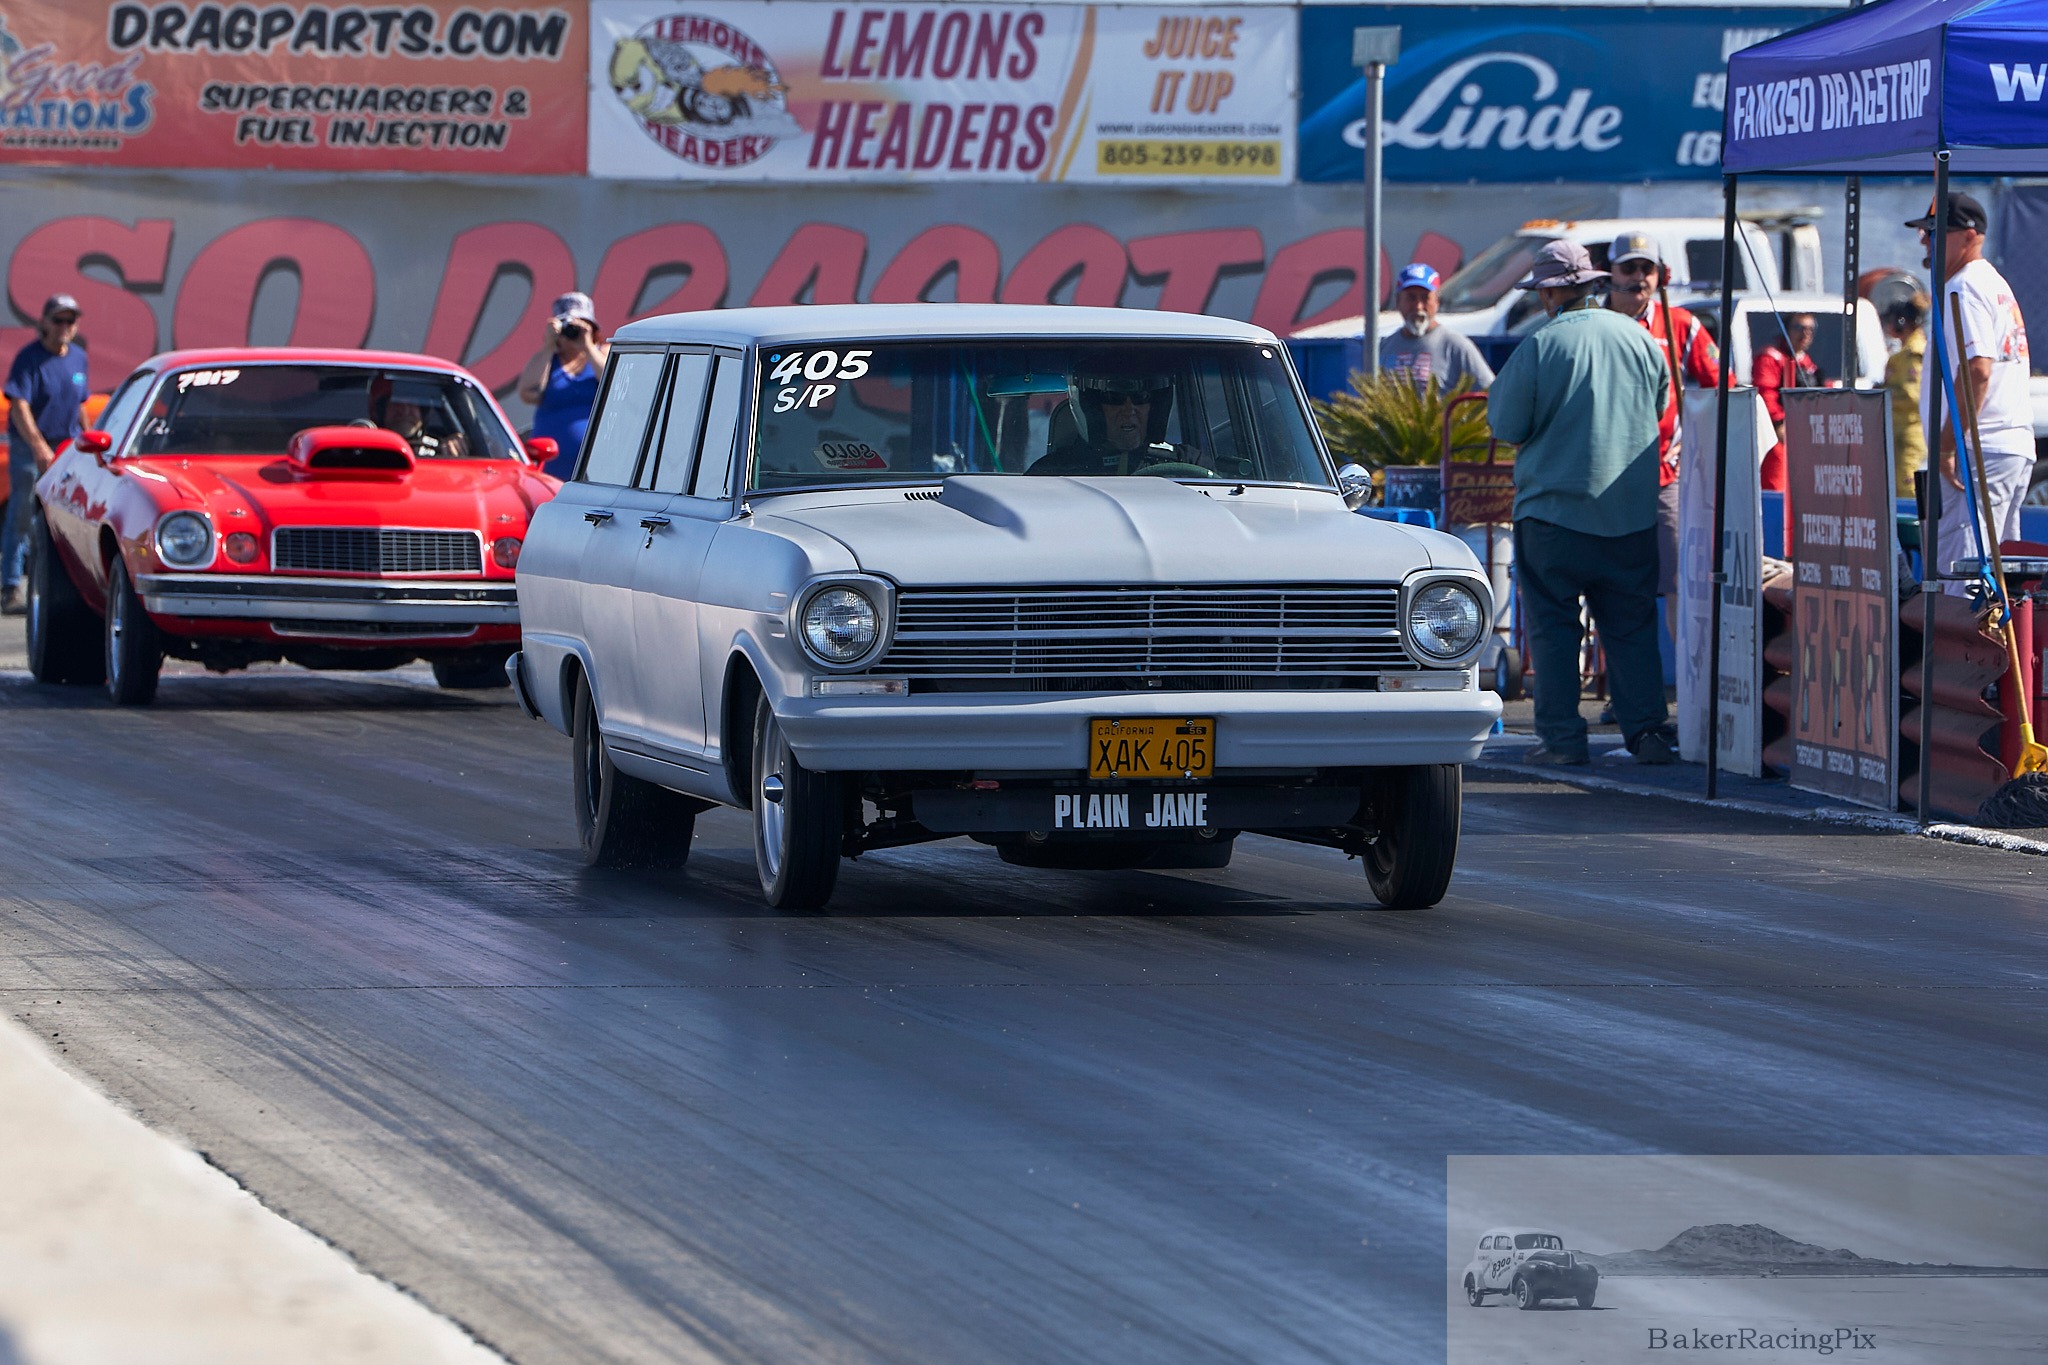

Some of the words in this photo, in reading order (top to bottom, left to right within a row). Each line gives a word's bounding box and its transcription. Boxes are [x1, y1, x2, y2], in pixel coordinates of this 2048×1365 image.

[111, 6, 568, 57] DRAGPARTS.COM
[820, 10, 1045, 81] LEMONS
[1143, 17, 1243, 60] JUICE
[0, 84, 152, 130] ATIONS
[202, 85, 494, 114] SUPERCHARGERS
[504, 90, 527, 114] &
[1150, 71, 1186, 114] IT
[1186, 71, 1235, 114] UP
[1342, 52, 1622, 151] Linde
[1734, 76, 1816, 141] FAMOSO
[1820, 58, 1932, 131] DRAGSTRIP
[236, 118, 315, 142] FUEL
[330, 121, 507, 147] INJECTION
[807, 101, 1055, 172] HEADERS
[1103, 145, 1276, 167] 805-239-8998
[770, 350, 873, 385] 405
[773, 384, 837, 413] S/P
[1097, 726, 1154, 736] CALIFORNIA
[1189, 727, 1203, 735] 56
[1095, 739, 1151, 772] XAK
[1159, 738, 1206, 771] 405
[1054, 793, 1130, 829] PLAIN
[1145, 792, 1208, 828] JANE
